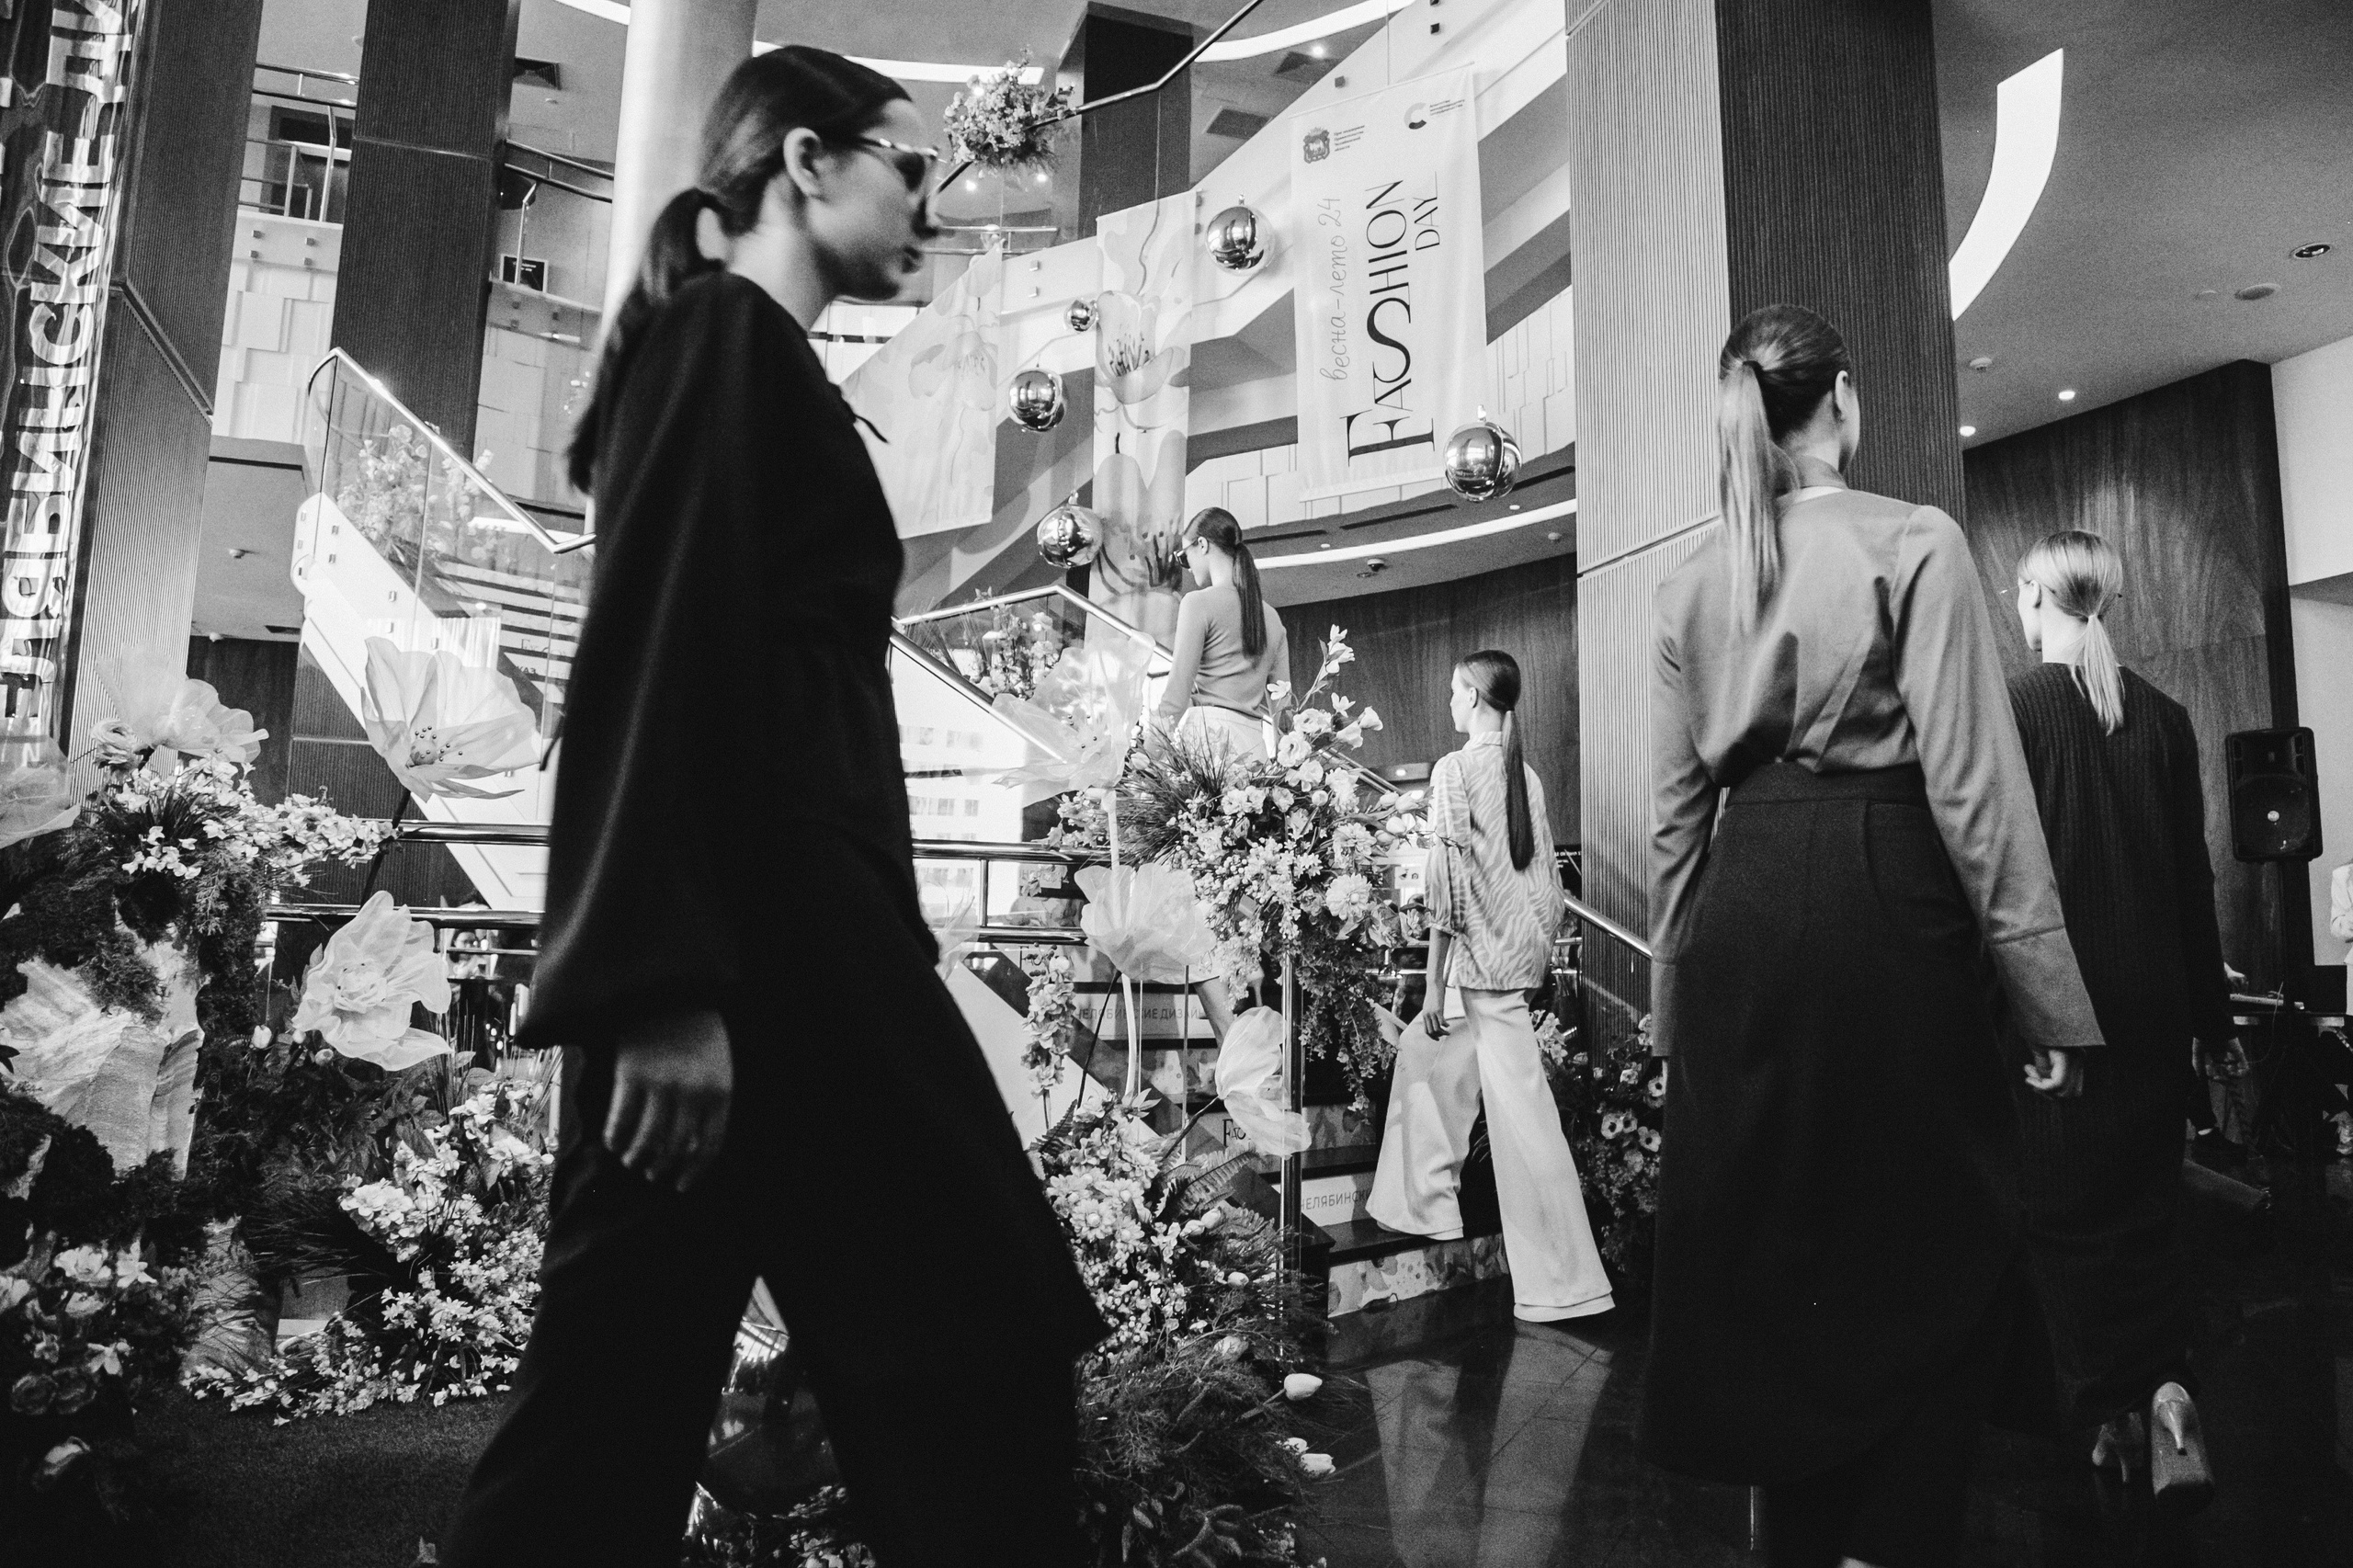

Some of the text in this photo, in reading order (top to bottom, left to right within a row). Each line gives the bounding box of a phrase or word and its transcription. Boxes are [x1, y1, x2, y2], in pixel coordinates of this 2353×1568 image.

[1317, 198, 1342, 227] 24
[1413, 171, 1440, 251] DAY
[1339, 180, 1435, 467] FASHION
[0, 131, 115, 768] ЕЛЯБИНСКИЕ
[1075, 1007, 1158, 1019] ЧЕЛЯБИКИЕ
